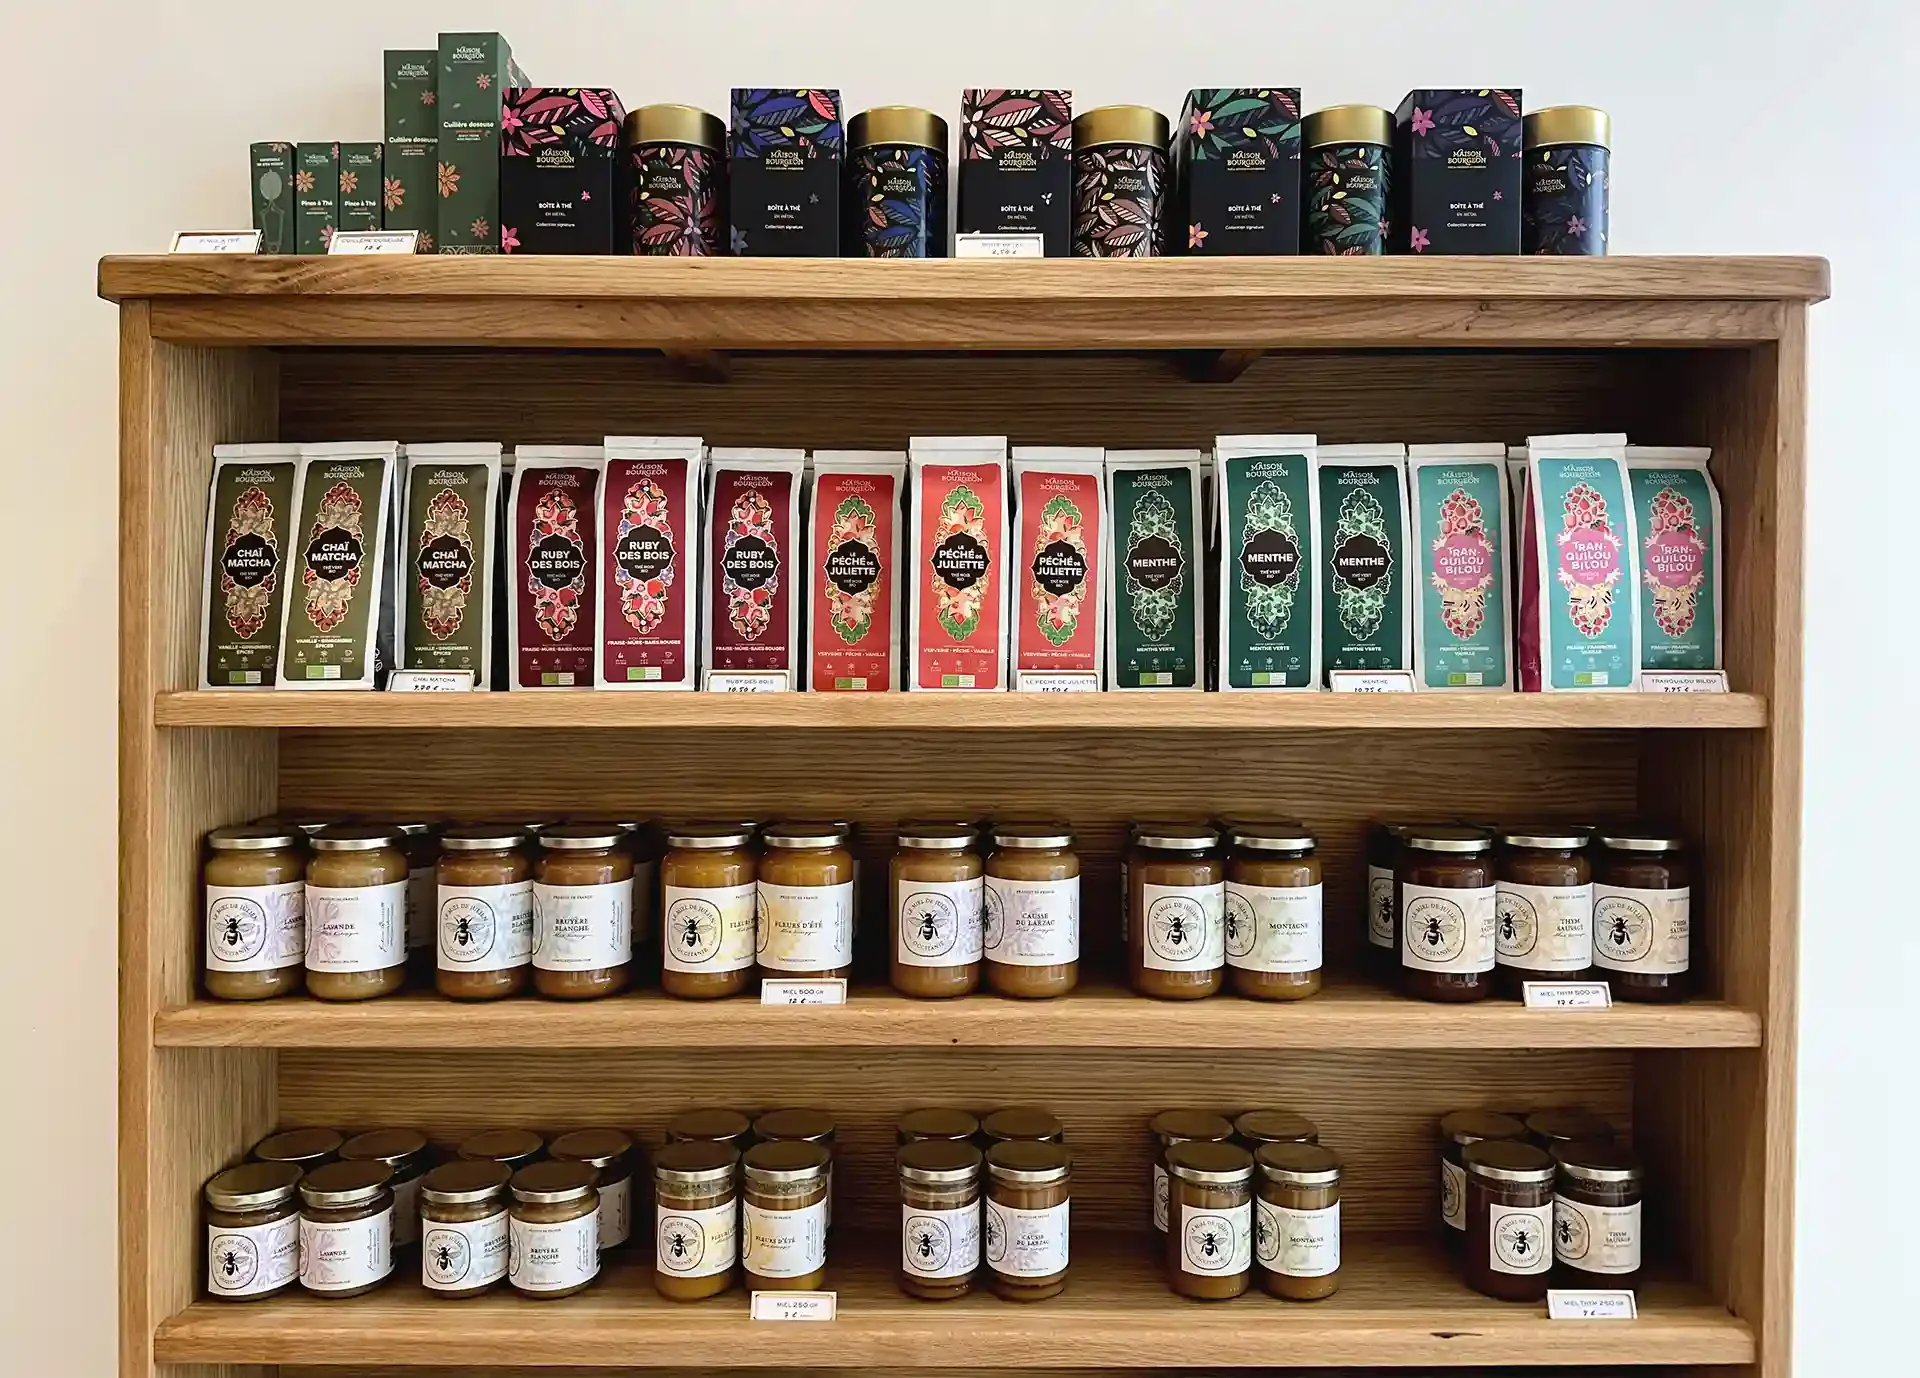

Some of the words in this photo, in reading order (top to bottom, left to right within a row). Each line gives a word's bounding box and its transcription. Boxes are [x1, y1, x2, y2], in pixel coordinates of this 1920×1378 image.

[456, 45, 481, 54] MAISON
[452, 52, 485, 61] BOURGEON
[443, 120, 469, 128] Cuillère
[388, 135, 415, 143] Cuillère
[416, 136, 438, 144] doseuse
[541, 149, 570, 158] MAISON
[770, 150, 799, 159] MAISON
[1003, 151, 1033, 160] MAISON
[1232, 151, 1261, 160] MAISON
[1452, 149, 1482, 158] MAISON
[536, 155, 575, 165] BOURGEON
[765, 157, 804, 166] BOURGEON
[998, 158, 1037, 167] BOURGEON
[1227, 158, 1266, 167] BOURGEON
[1447, 156, 1487, 165] BOURGEON
[538, 201, 556, 210] BOÎTE
[561, 201, 572, 209] THÉ
[767, 204, 784, 212] BOÎTE
[785, 204, 790, 212] À
[790, 204, 801, 212] THÉ
[1000, 204, 1017, 213] BOÎTE
[1018, 205, 1023, 213] À
[1024, 205, 1034, 213] THÉ
[1228, 204, 1245, 213] BOÎTE
[1449, 202, 1466, 210] BOÎTE
[1251, 462, 1283, 471] MAISON
[625, 468, 668, 477] BOURGEON
[1245, 469, 1289, 478] BOURGEON
[1343, 471, 1373, 479] MAISON
[1137, 474, 1167, 482] MAISON
[1338, 477, 1380, 486] BOURGEON
[733, 480, 774, 489] BOURGEON
[1132, 479, 1173, 488] BOURGEON
[322, 542, 348, 552] CHAÏ
[629, 540, 660, 550] RUBY
[237, 547, 262, 558] CHAÏ
[311, 552, 357, 562] MATCHA
[432, 549, 458, 560] CHAÏ
[541, 550, 570, 560] RUBY
[619, 551, 641, 560] DES
[643, 550, 670, 560] BOIS
[735, 550, 765, 560] RUBY
[939, 548, 974, 560] PÉCHÉ
[1566, 551, 1611, 562] QUILOU
[832, 555, 866, 566] PÉCHÉ
[1039, 555, 1073, 566] PÉCHÉ
[1132, 557, 1177, 568] MENTHE
[1247, 553, 1293, 563] MENTHE
[1339, 557, 1384, 566] MENTHE
[1439, 555, 1485, 566] QUILOU
[1651, 554, 1696, 565] QUILOU
[227, 558, 271, 568] MATCHA
[423, 560, 467, 570] MATCHA
[532, 560, 552, 570] DES
[554, 560, 580, 569] BOIS
[727, 560, 747, 569] DES
[749, 560, 774, 569] BOIS
[937, 559, 985, 570] JULIETTE
[1571, 560, 1609, 571] BILOU
[1657, 562, 1693, 573] BILOU
[830, 566, 876, 576] JULIETTE
[1037, 566, 1083, 576] JULIETTE
[1445, 565, 1482, 575] BILOU
[322, 922, 355, 931] LAVANDE
[554, 924, 590, 932] BLANCHE
[775, 920, 800, 928] FLEURS
[1269, 922, 1308, 930] MONTAGNE
